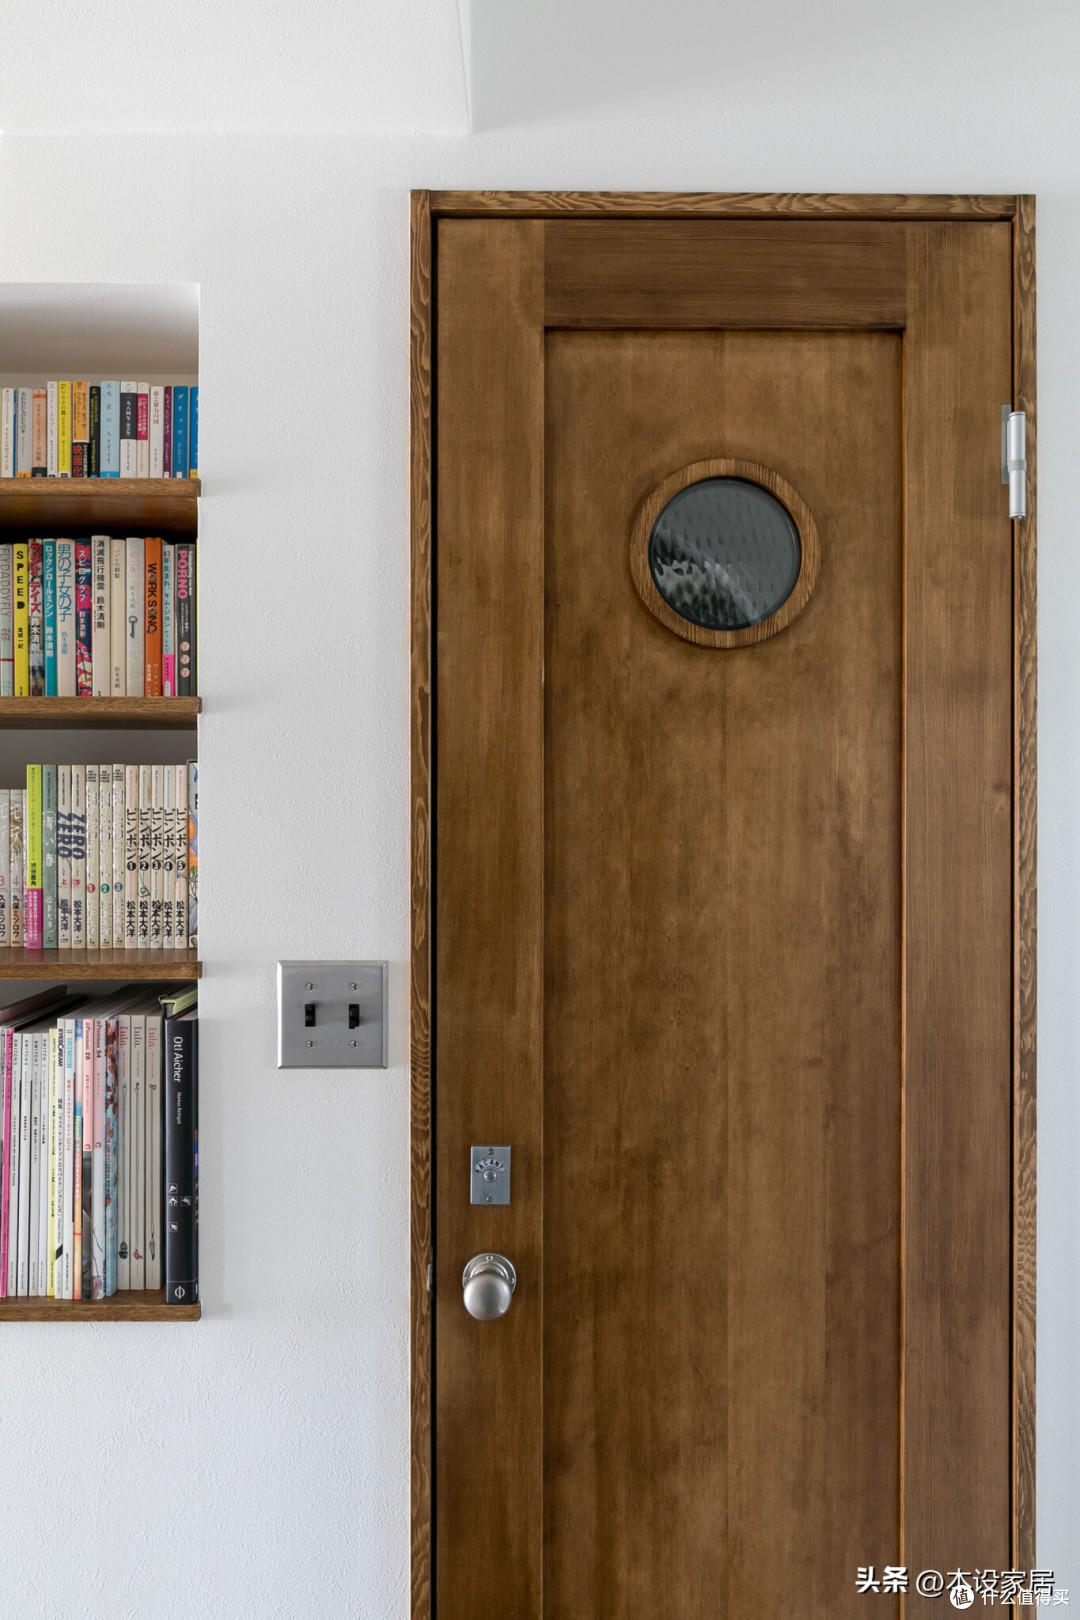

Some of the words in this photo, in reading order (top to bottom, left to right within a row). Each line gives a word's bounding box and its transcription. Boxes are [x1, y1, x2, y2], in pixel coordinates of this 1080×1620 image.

[73, 444, 83, 477] 映画化
[17, 551, 25, 610] SPEED
[46, 546, 54, 617] ロックンロールミシン
[58, 543, 73, 622] 男の子女の子
[78, 550, 86, 602] スピログラフ
[96, 539, 105, 591] 消滅飛行機雲
[147, 563, 157, 597] WORK
[178, 550, 188, 599] PORNO
[96, 596, 105, 630] 鈴木清剛
[58, 811, 71, 858] ZERO
[72, 811, 85, 860] ZERO
[126, 808, 137, 861] ピンポン
[139, 808, 150, 861] ピンポン
[151, 808, 162, 861] ピンポン
[164, 808, 175, 861] ピンポン
[176, 808, 186, 861] ピンポン
[126, 901, 135, 937] 松本大洋
[139, 901, 147, 937] 松本大洋
[151, 901, 159, 937] 松本大洋
[164, 901, 172, 937] 松本大洋
[176, 901, 184, 937] 松本大洋
[173, 1036, 183, 1051] Otl
[173, 1052, 183, 1082] Aicher
